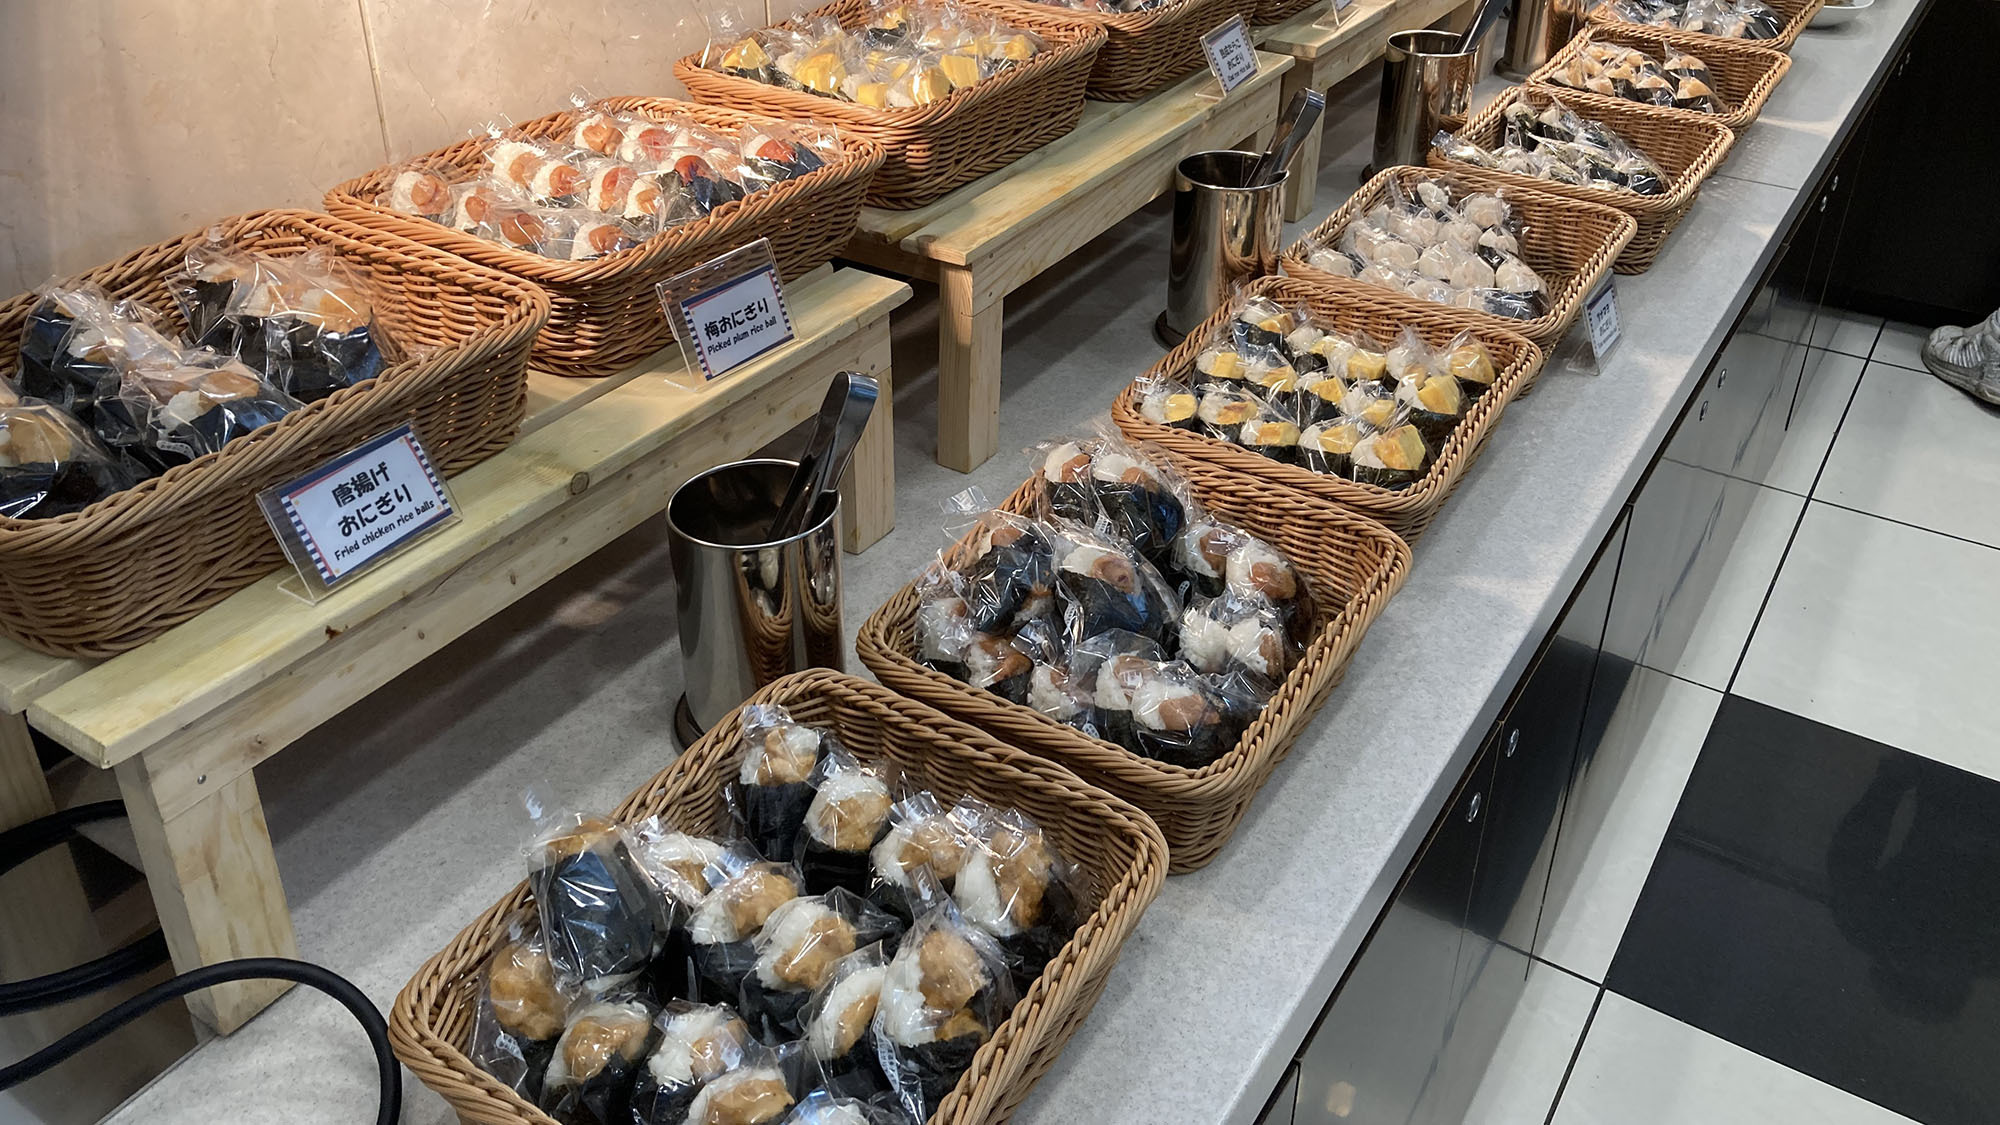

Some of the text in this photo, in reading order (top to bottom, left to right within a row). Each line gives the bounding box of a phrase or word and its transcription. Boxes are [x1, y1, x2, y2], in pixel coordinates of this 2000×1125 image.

[1227, 52, 1245, 70] おにぎり
[704, 297, 769, 341] 梅おにぎり
[707, 316, 778, 355] Picked plum rice ball
[331, 461, 390, 508] 唐揚げ
[334, 498, 435, 561] Fried chicken rice balls
[337, 483, 413, 538] おにぎり
